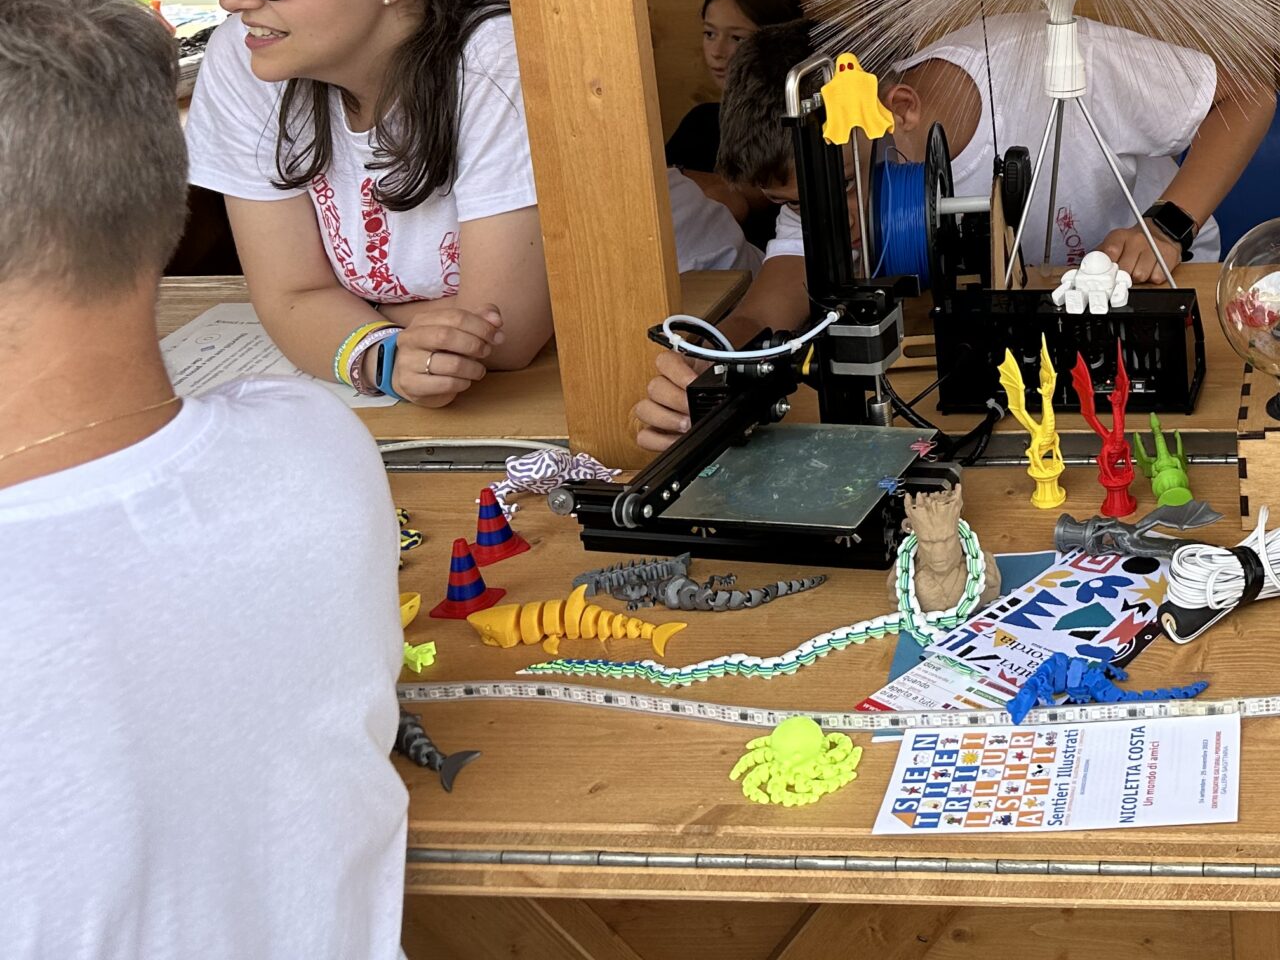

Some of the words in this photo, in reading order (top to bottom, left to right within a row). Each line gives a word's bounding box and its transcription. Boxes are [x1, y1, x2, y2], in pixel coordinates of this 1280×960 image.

[887, 684, 913, 700] aperto
[902, 674, 931, 690] quando
[1057, 728, 1079, 778] Illustrati
[1129, 725, 1146, 761] COSTA
[1149, 740, 1160, 762] amici
[1148, 762, 1158, 770] di
[1119, 764, 1141, 824] NICOLETTA
[1145, 770, 1158, 796] mondo
[1047, 782, 1068, 826] Sentieri
[1143, 796, 1154, 807] Un
